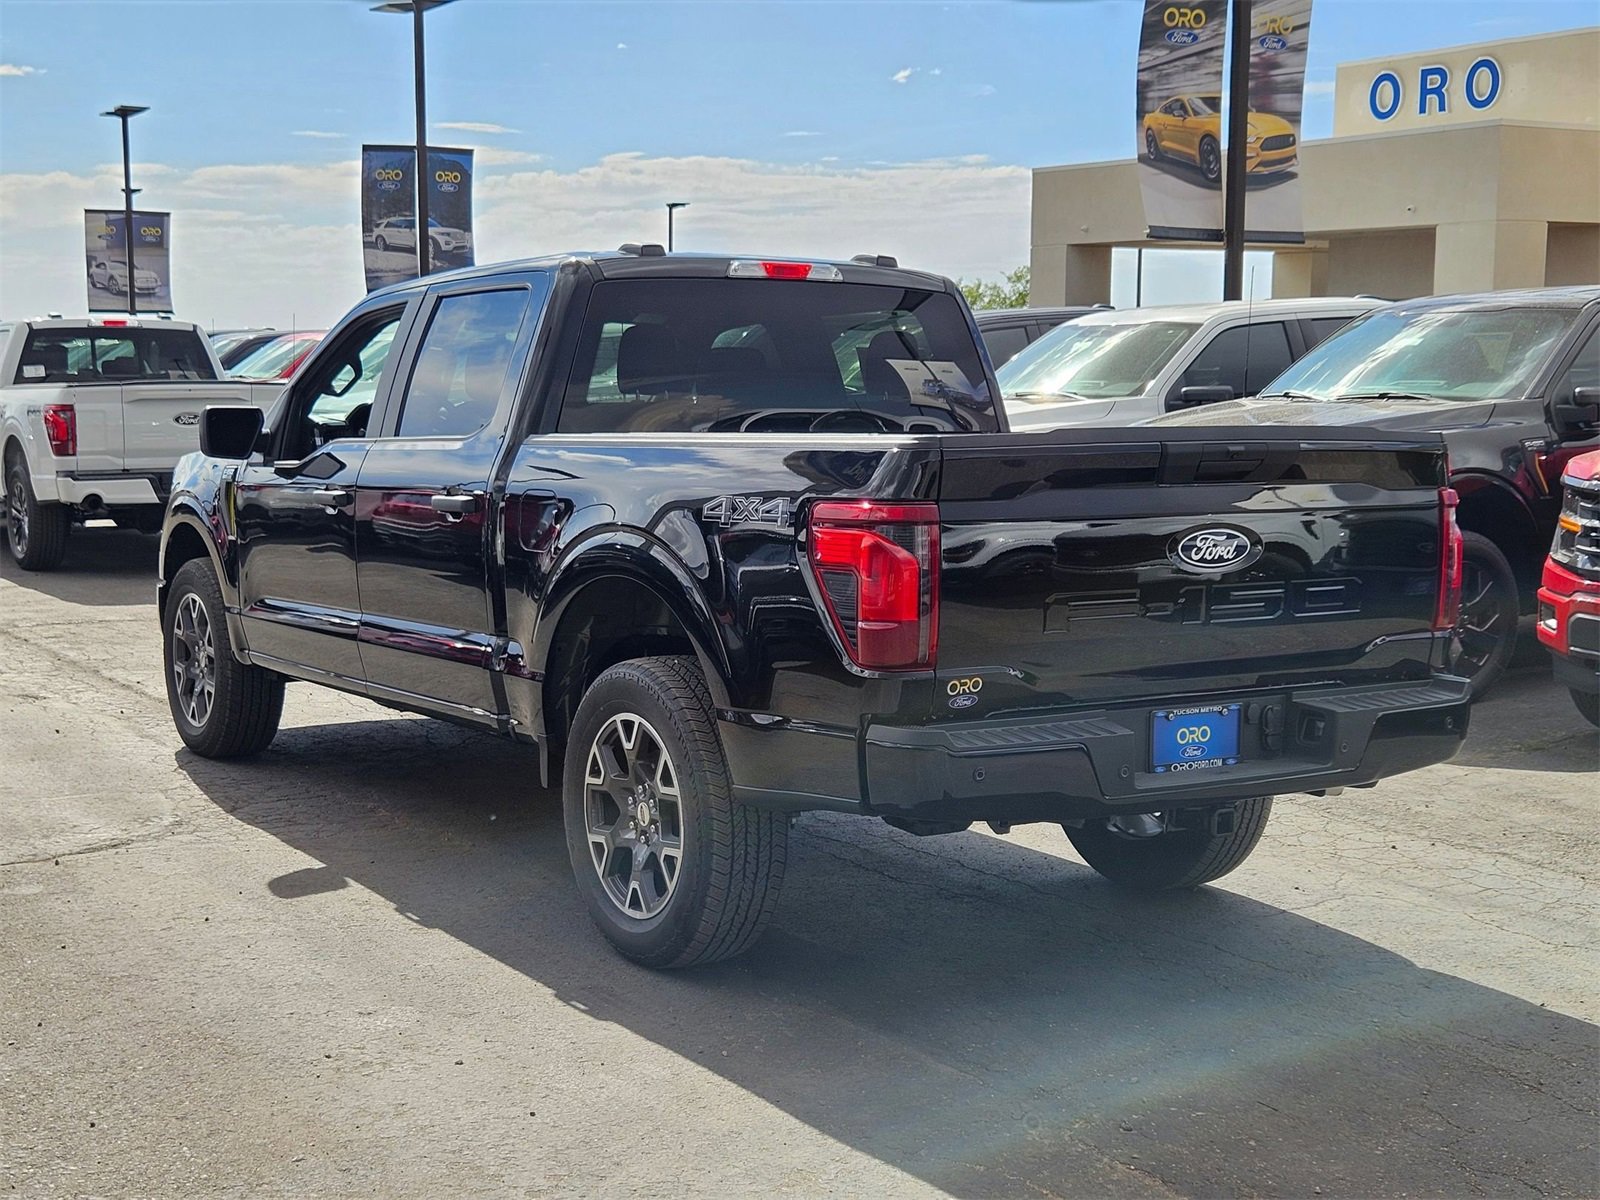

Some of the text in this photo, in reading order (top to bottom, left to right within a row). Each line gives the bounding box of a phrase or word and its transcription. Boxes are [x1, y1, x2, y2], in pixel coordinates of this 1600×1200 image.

[1163, 7, 1206, 28] ORO
[1369, 55, 1502, 122] ORO
[375, 169, 403, 181] ORO
[435, 171, 461, 183] ORO
[1043, 576, 1364, 634] F-150
[946, 677, 983, 696] ORO
[1172, 706, 1200, 715] TUCSON
[1200, 704, 1223, 713] METRO
[1176, 725, 1211, 745] ORO
